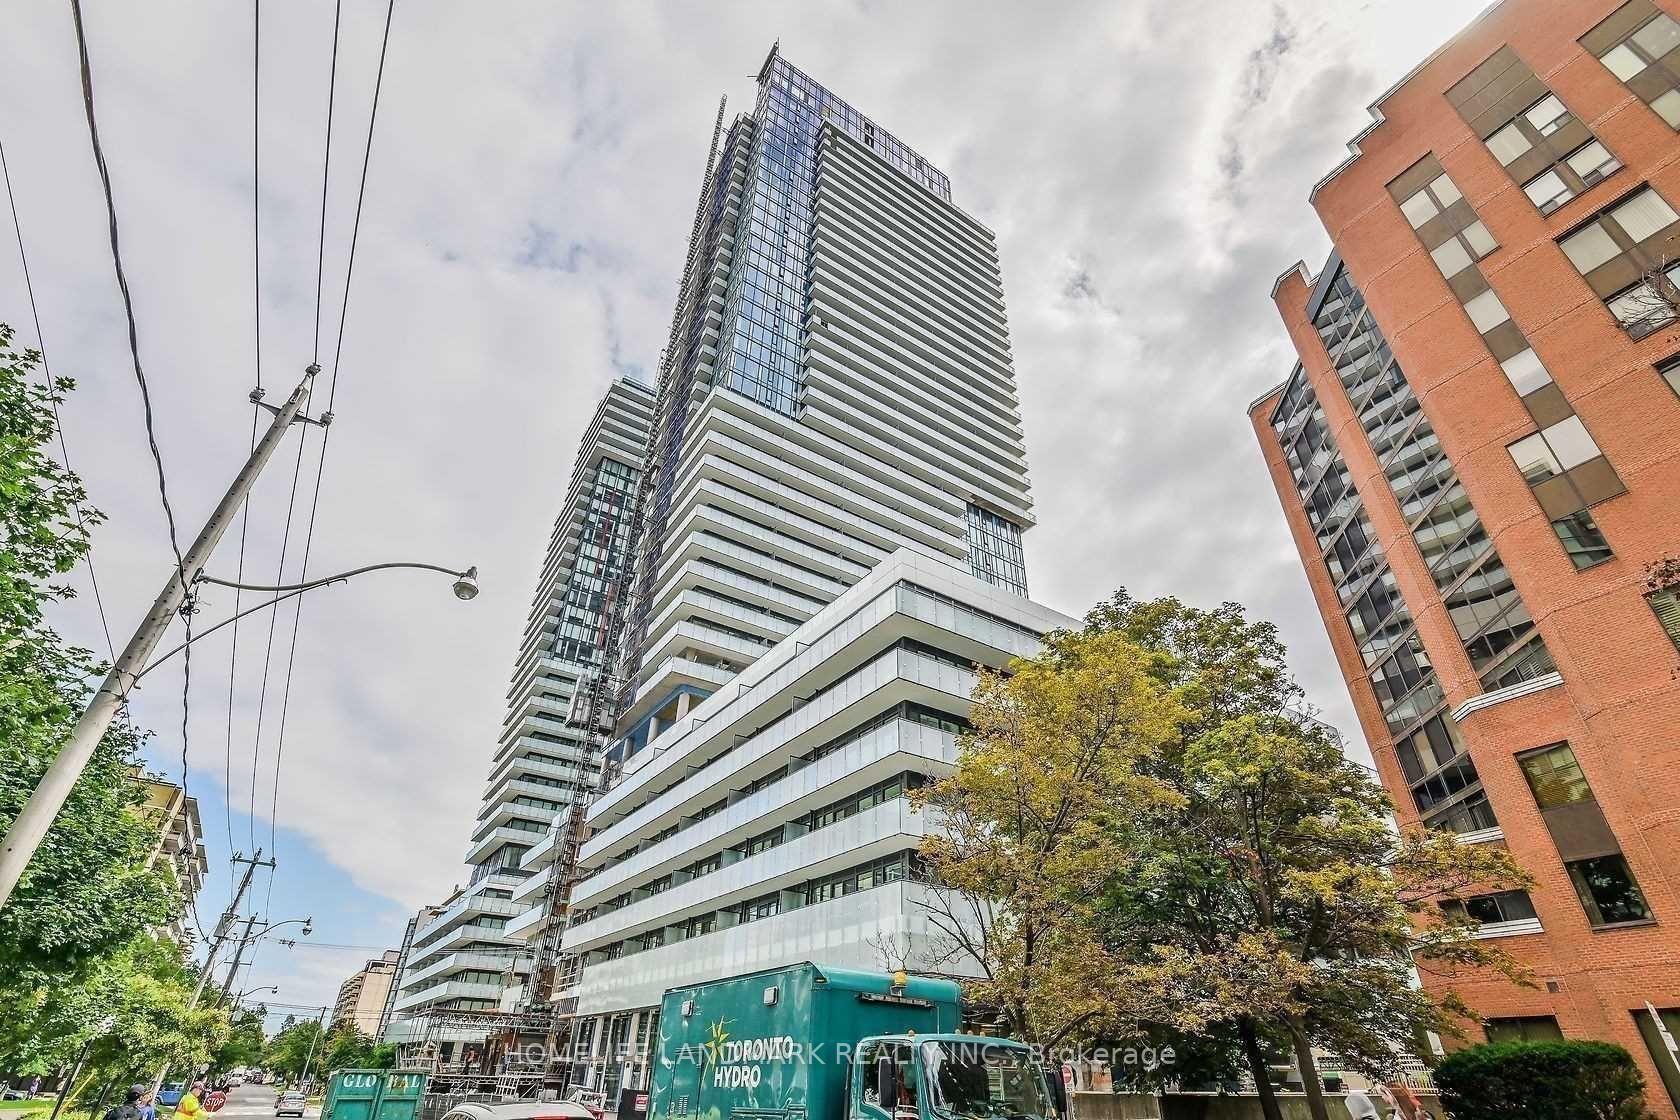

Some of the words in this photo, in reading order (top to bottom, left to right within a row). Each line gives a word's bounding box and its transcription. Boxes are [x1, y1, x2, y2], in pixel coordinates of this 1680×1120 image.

[727, 1036, 793, 1061] TORONTO
[714, 1065, 760, 1088] HYDRO
[206, 1098, 224, 1107] STOP
